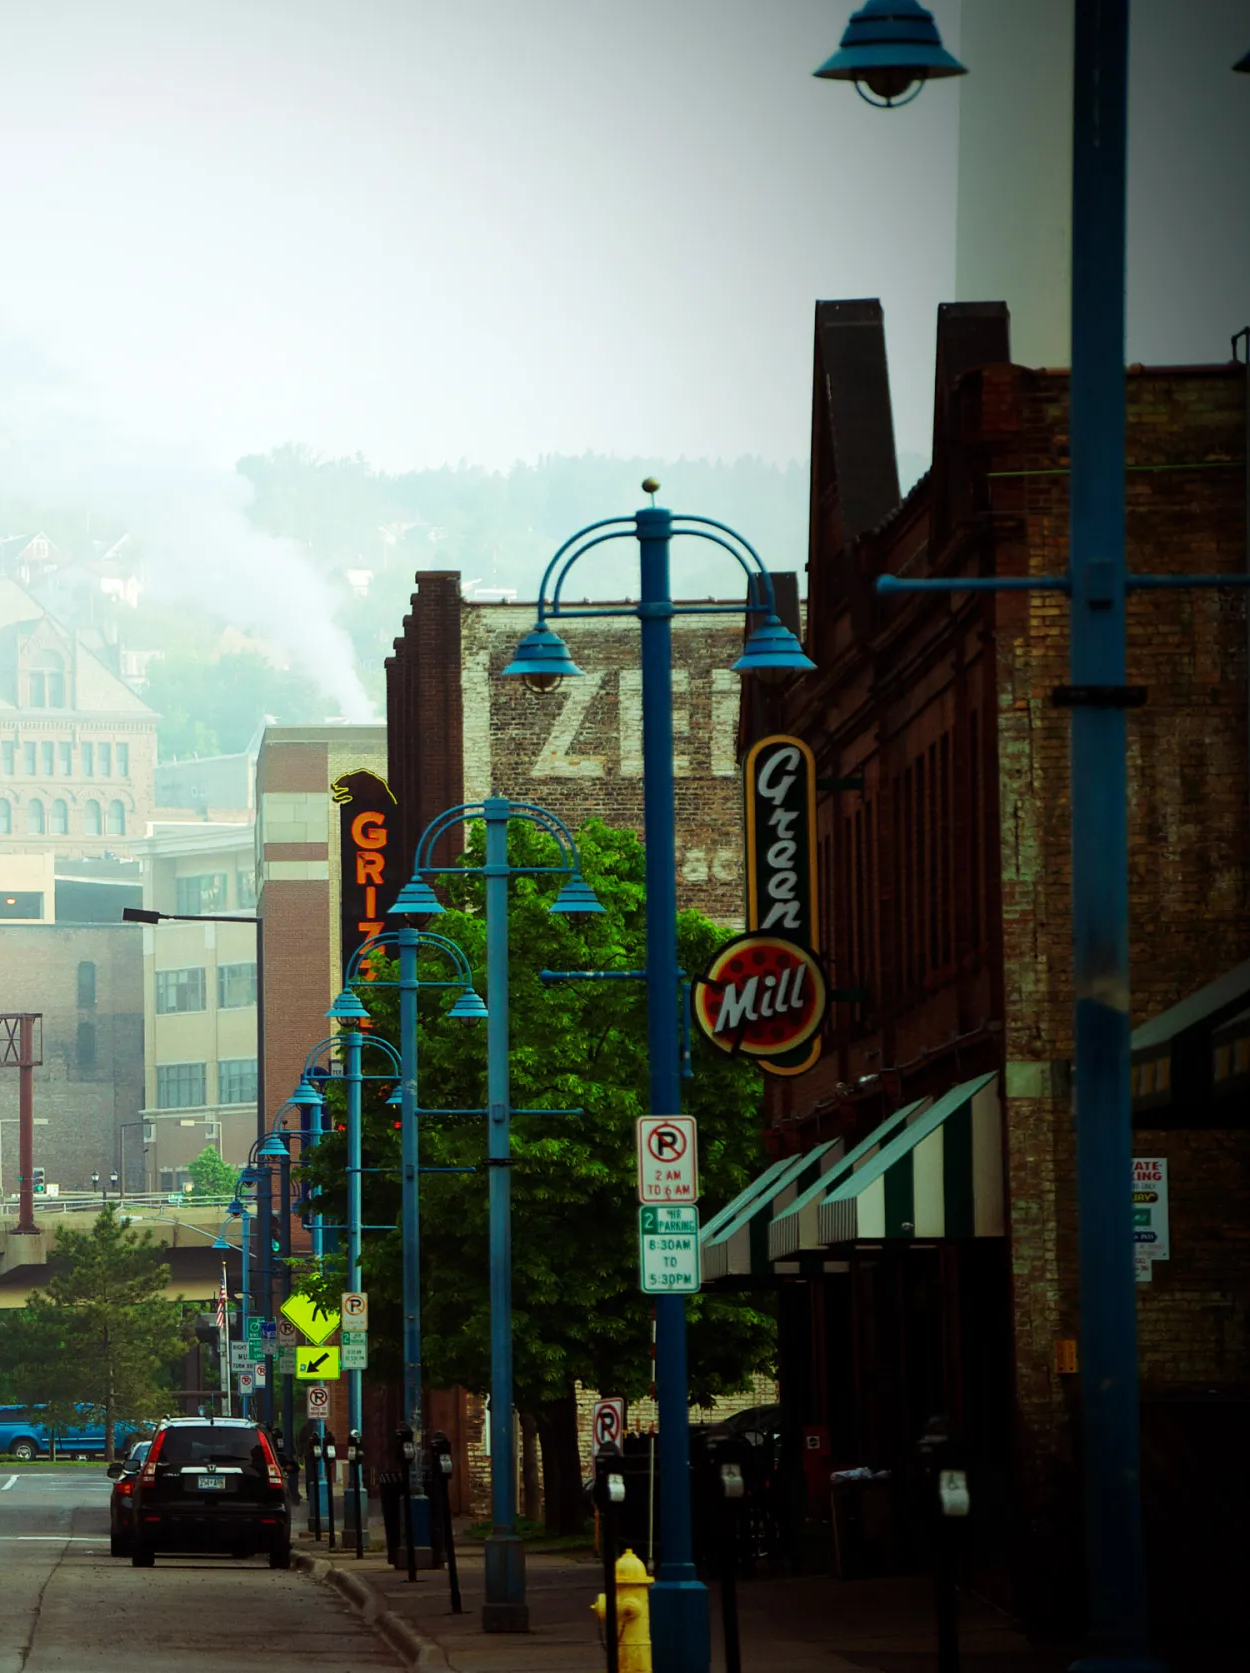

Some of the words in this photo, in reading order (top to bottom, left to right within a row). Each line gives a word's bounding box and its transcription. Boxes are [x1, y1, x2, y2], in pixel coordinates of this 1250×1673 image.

[757, 746, 802, 930] Green
[713, 962, 807, 1033] Mill
[655, 1169, 662, 1181] 2
[667, 1169, 681, 1180] AM
[648, 1184, 661, 1195] TO
[675, 1184, 690, 1194] AM
[644, 1212, 655, 1229] 2
[658, 1220, 695, 1231] PARKING
[664, 1256, 678, 1268] TO
